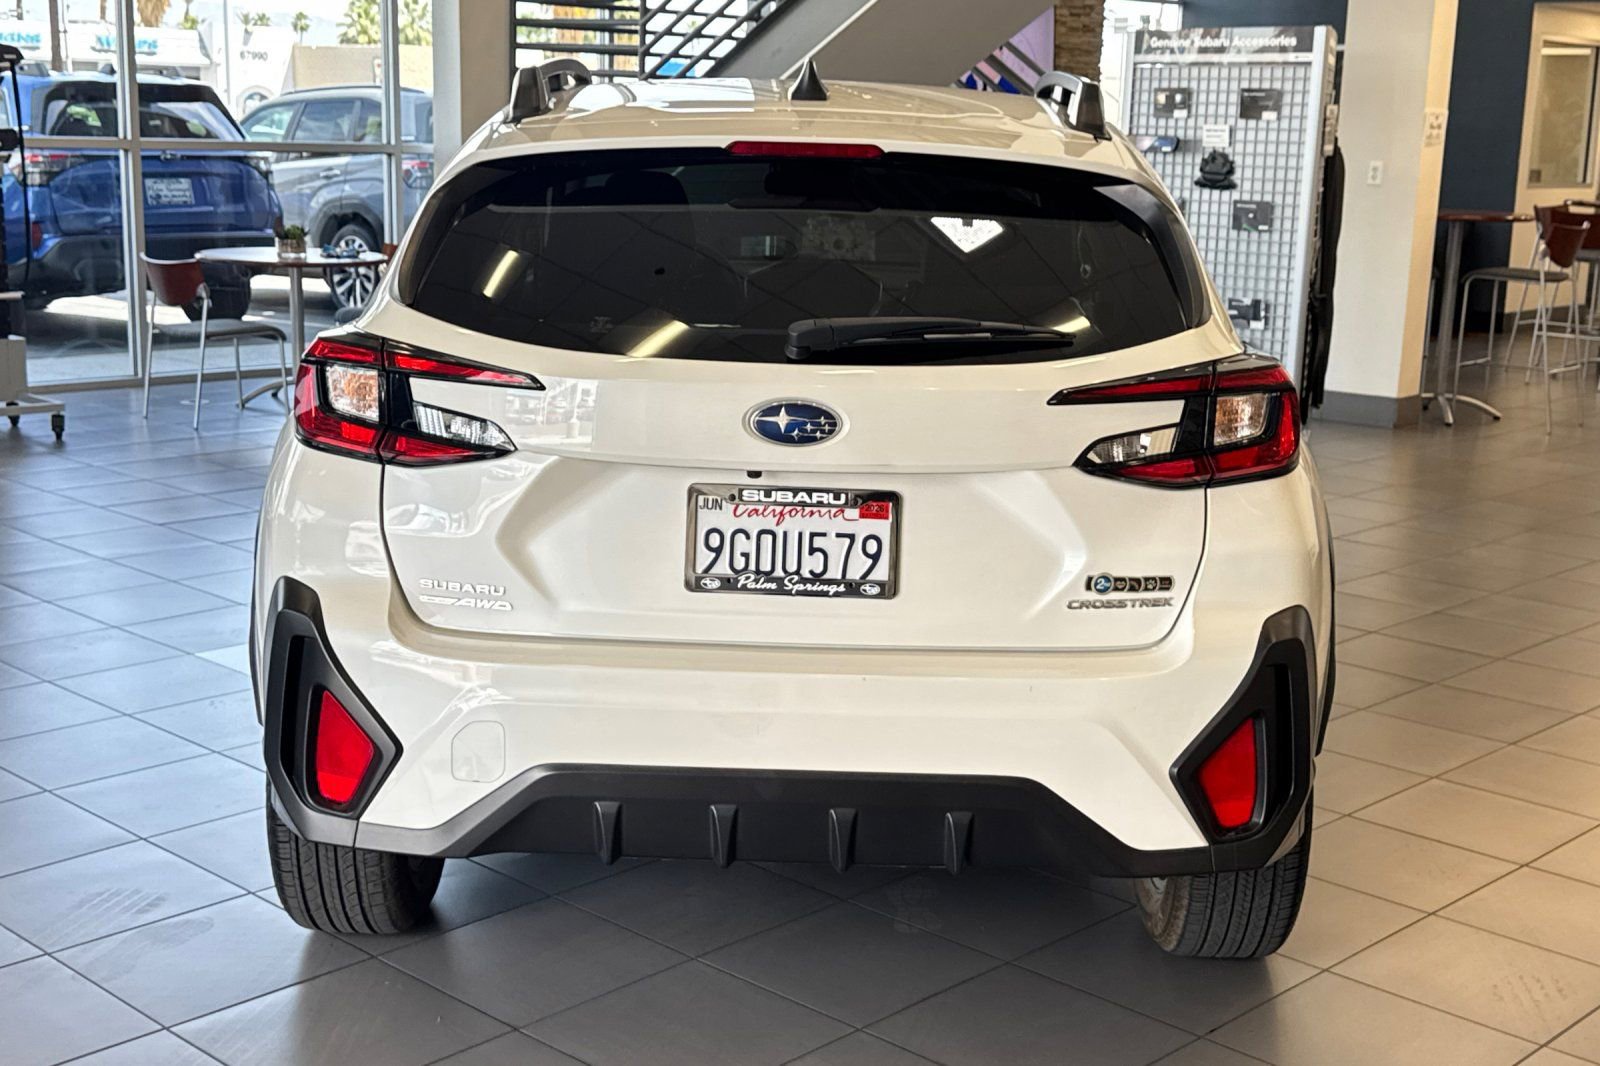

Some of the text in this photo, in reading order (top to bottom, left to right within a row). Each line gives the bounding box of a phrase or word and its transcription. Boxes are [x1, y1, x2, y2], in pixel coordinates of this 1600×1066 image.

[1194, 36, 1230, 47] Subaru
[1232, 34, 1298, 47] Accessories
[699, 497, 722, 510] JUN
[742, 489, 846, 504] SUBARU
[732, 503, 860, 526] California
[419, 578, 506, 596] SUBARU
[737, 573, 846, 595] Palm Springs
[454, 597, 513, 611] AWD
[1067, 597, 1174, 609] CROSSTREK
